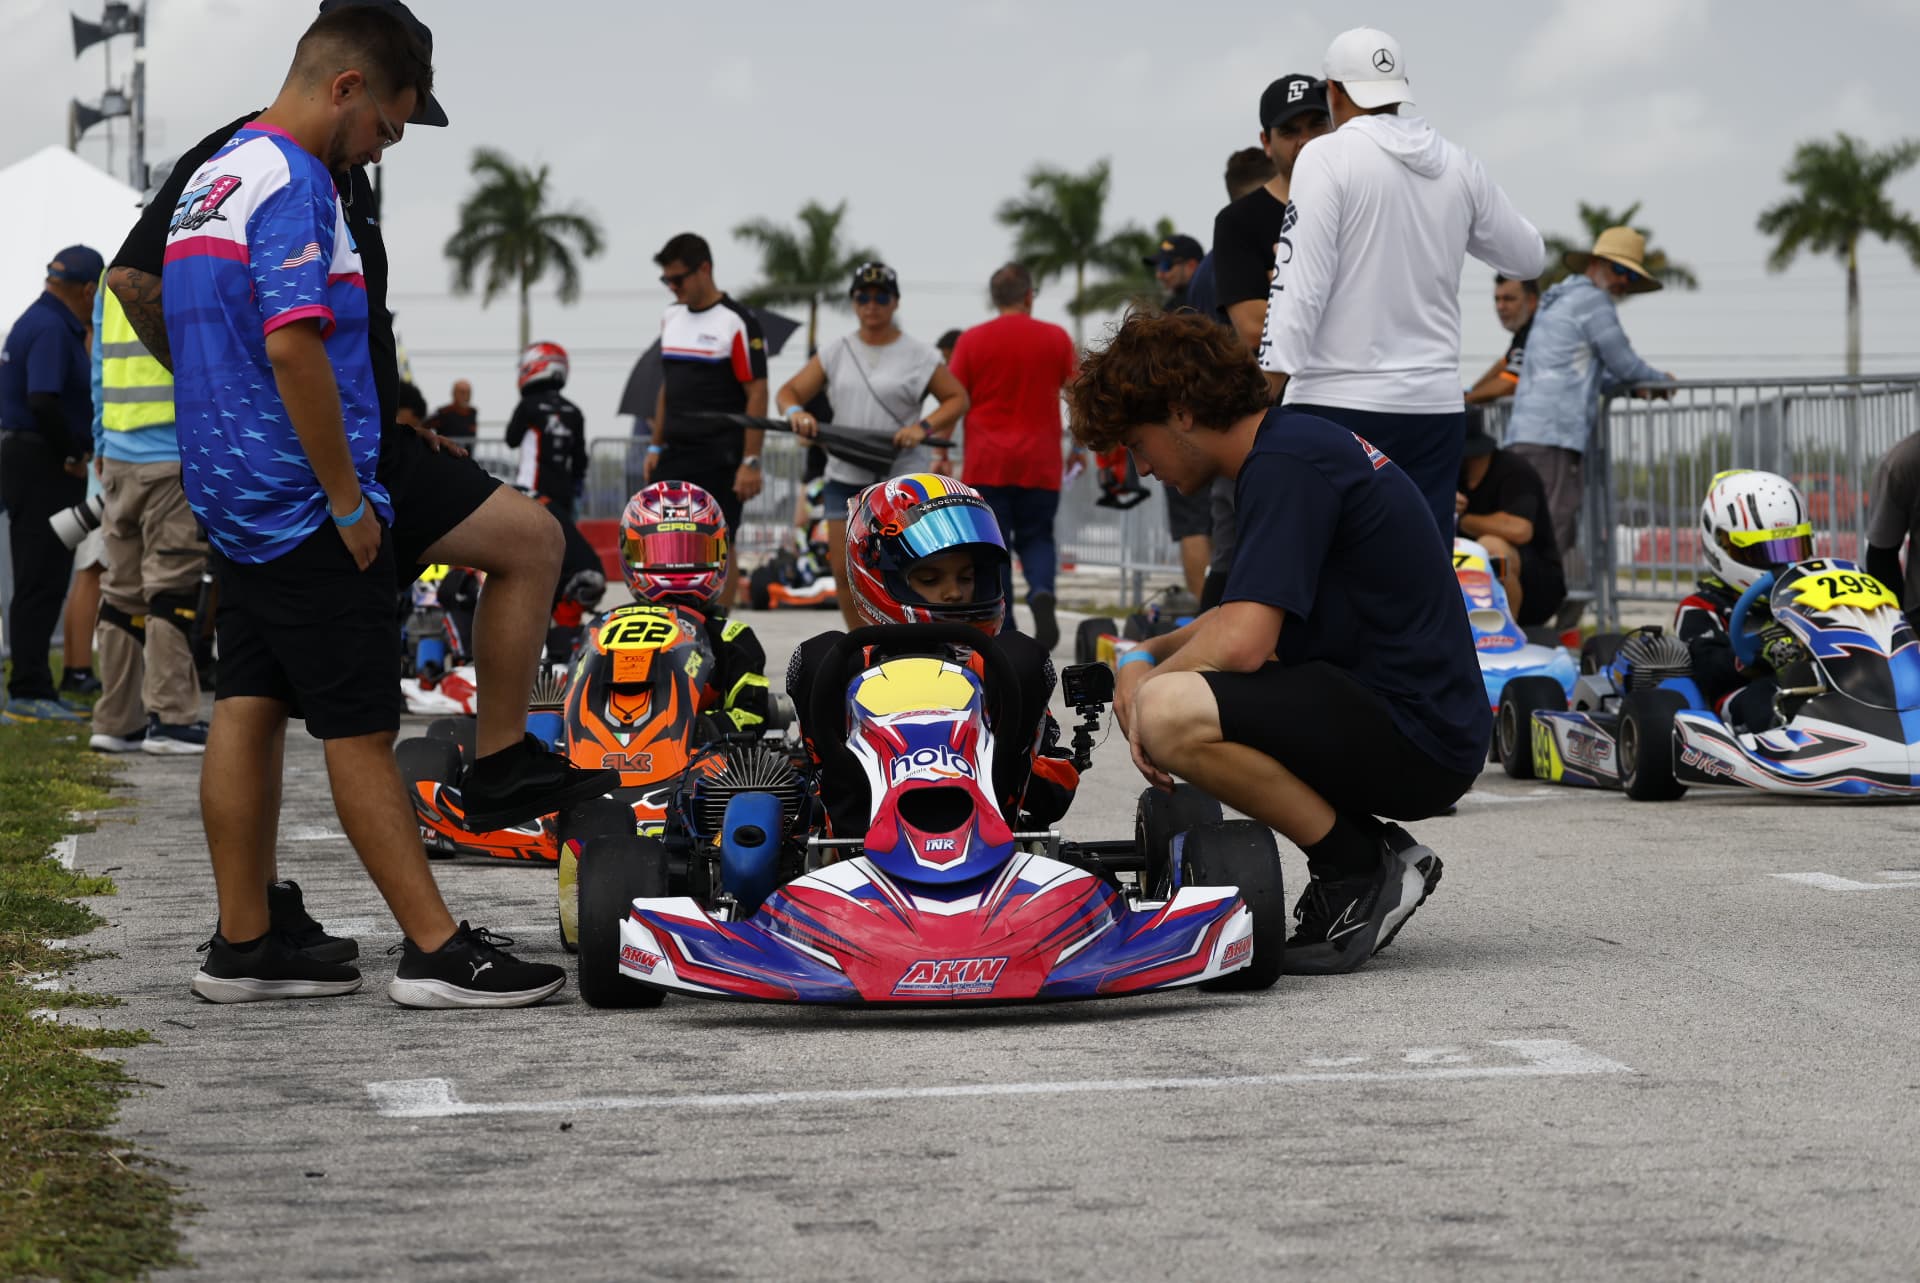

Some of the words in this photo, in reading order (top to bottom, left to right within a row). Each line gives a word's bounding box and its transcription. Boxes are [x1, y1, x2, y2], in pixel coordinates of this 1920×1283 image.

[1816, 574, 1882, 599] 299
[602, 621, 673, 645] 122
[899, 957, 1009, 985] AKW
